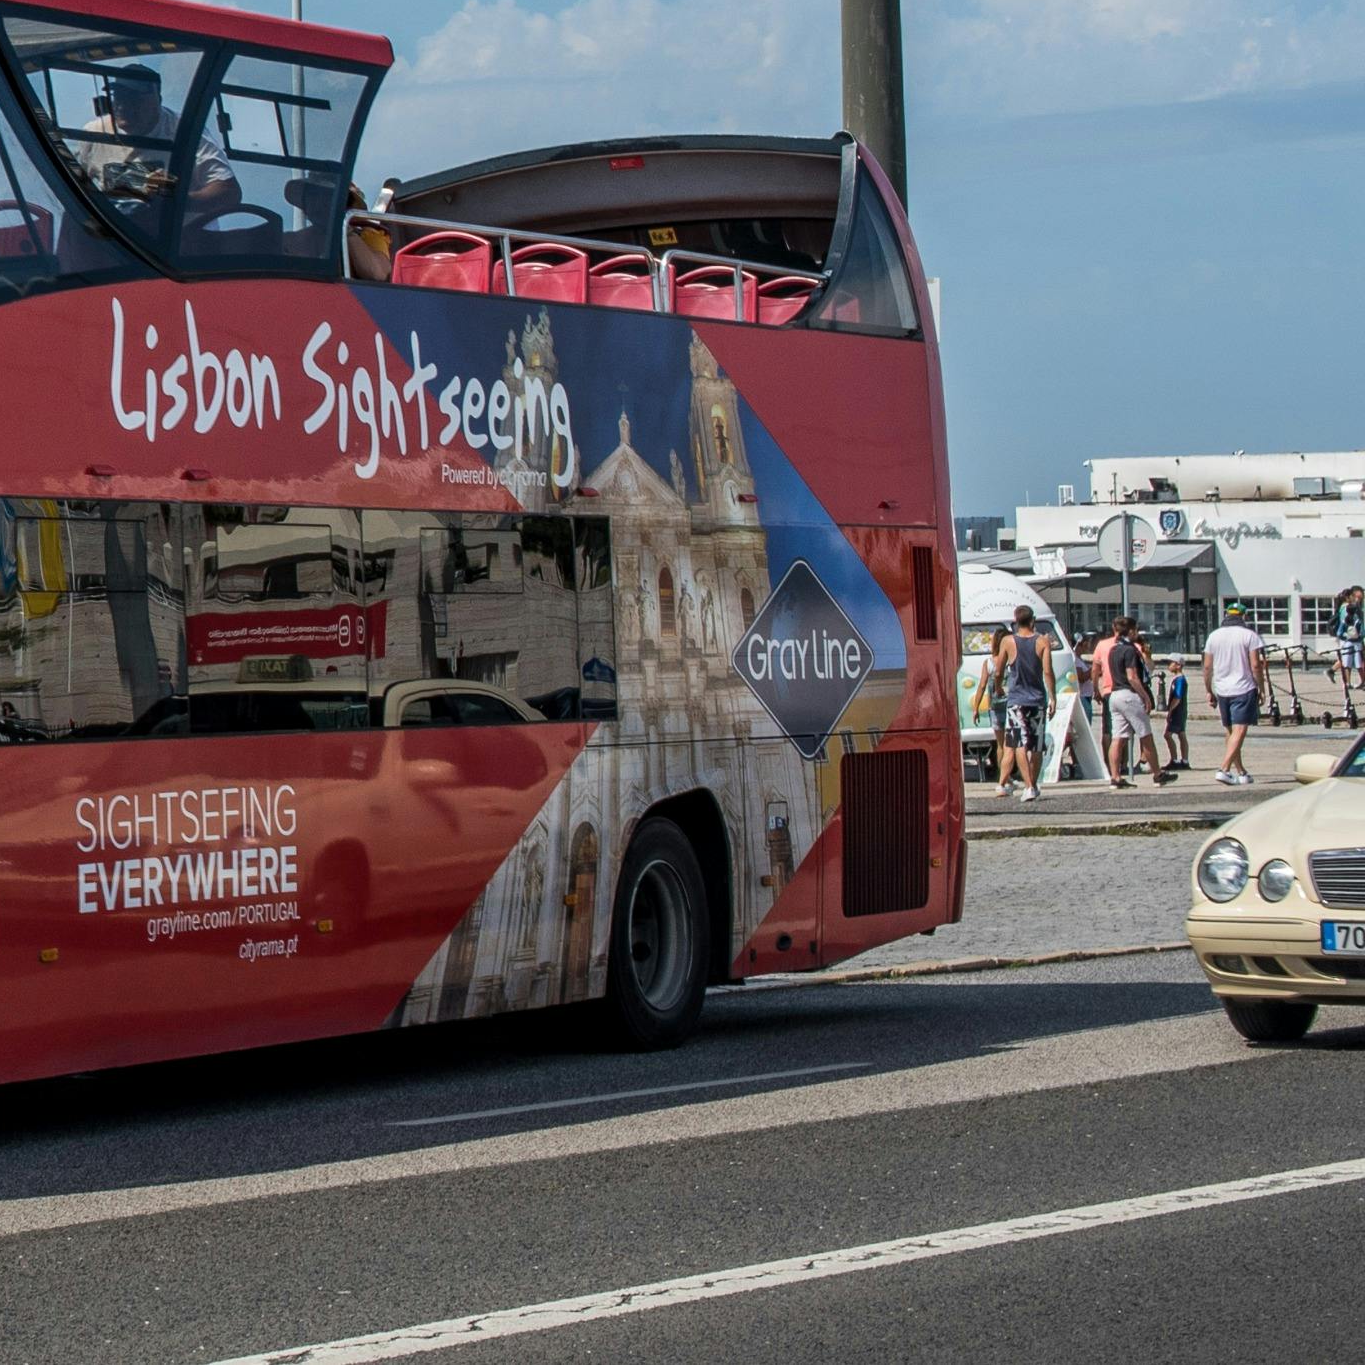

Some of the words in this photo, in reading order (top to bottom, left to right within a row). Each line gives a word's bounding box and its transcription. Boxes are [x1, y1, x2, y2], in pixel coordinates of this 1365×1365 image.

[111, 297, 280, 443] Lisbon
[303, 321, 575, 487] Sightseeing
[441, 464, 485, 485] Powered
[487, 467, 499, 490] by
[747, 633, 809, 681] Gray
[812, 629, 861, 679] Line
[78, 845, 298, 914] EVERYWHERE
[147, 901, 301, 941] grayline.com/PORTUGAL
[239, 934, 299, 963] cityrama.pt
